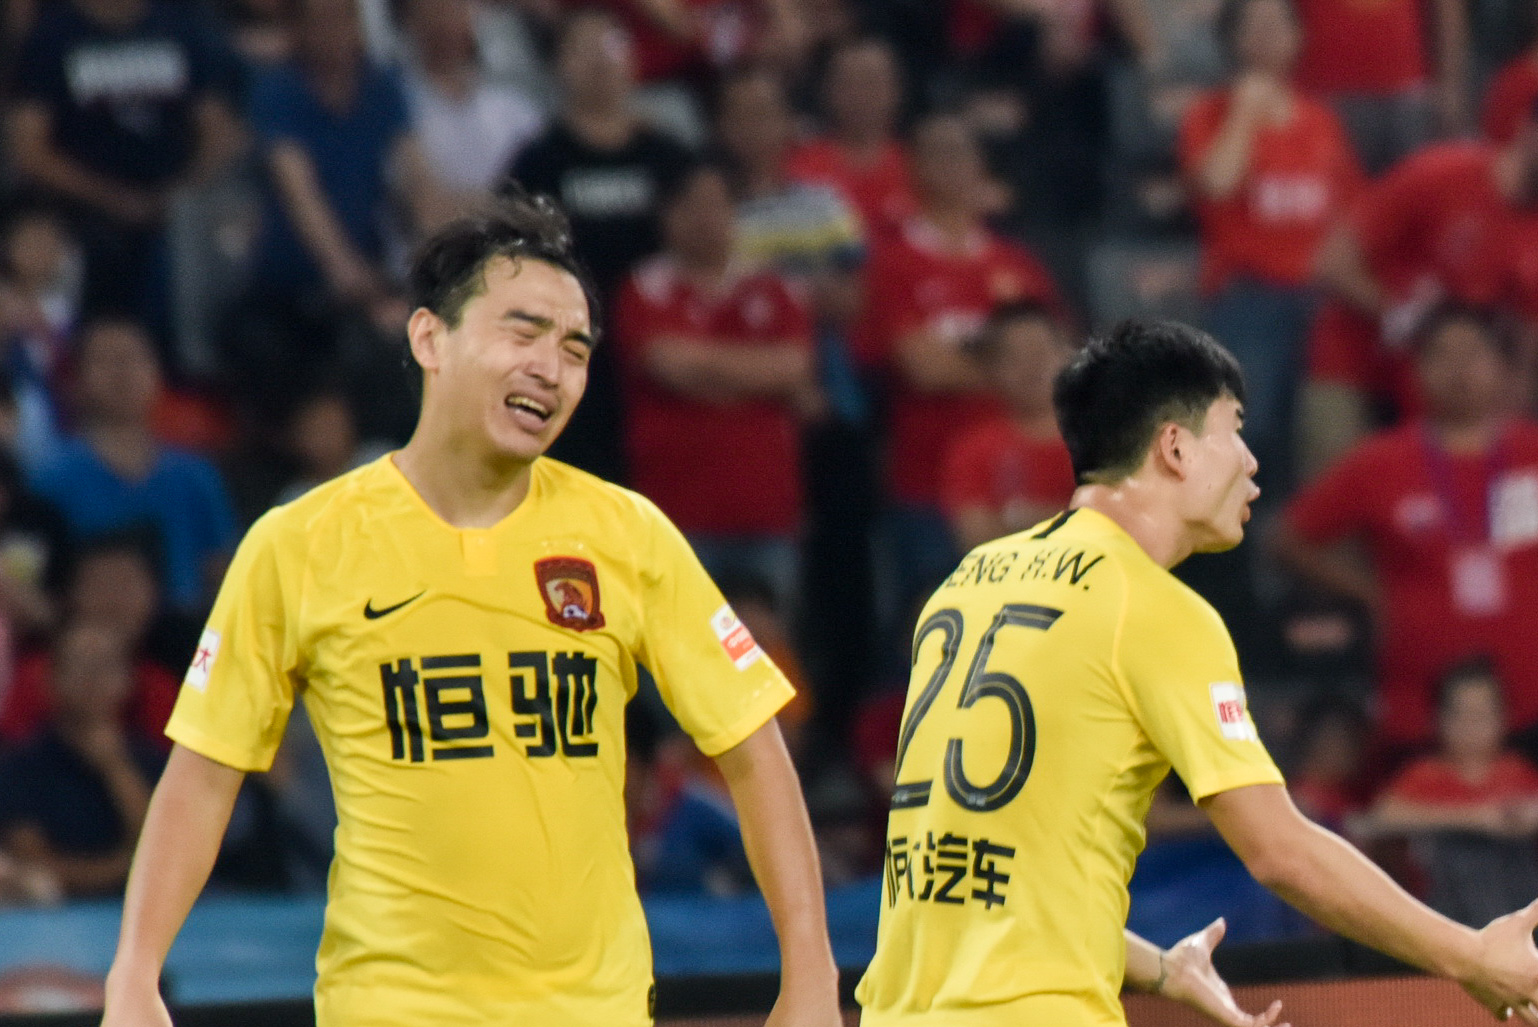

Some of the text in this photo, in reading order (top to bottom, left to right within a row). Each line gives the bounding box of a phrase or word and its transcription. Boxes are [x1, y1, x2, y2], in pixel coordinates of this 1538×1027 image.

[944, 552, 1018, 588] ENG
[379, 650, 599, 763] 恒驰
[890, 603, 1066, 813] 25
